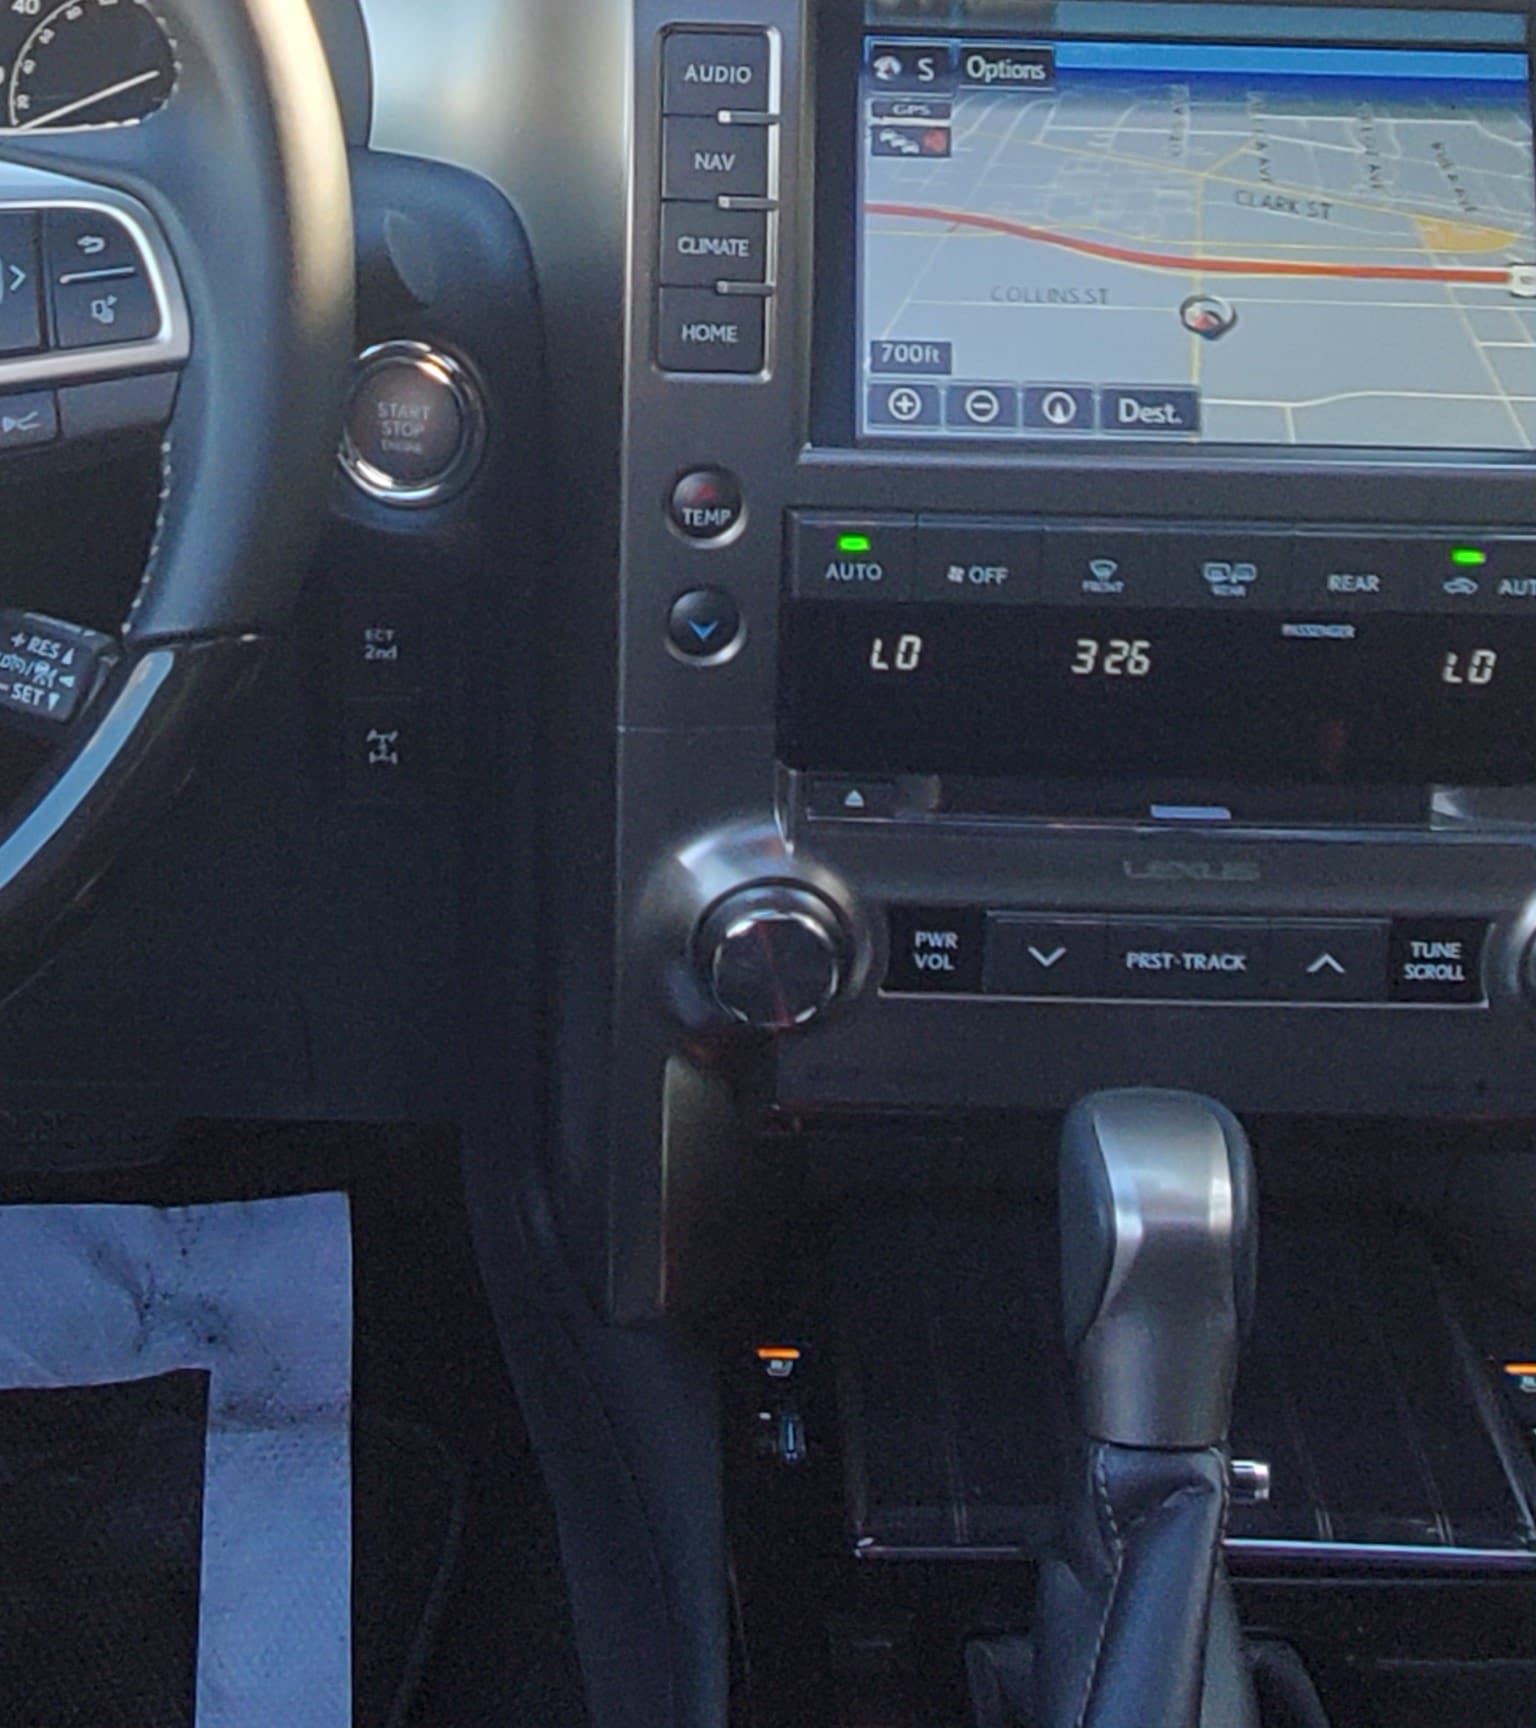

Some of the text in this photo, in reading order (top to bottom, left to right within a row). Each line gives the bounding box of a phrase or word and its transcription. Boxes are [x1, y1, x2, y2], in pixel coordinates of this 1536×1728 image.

[684, 64, 752, 83] AUDIO
[917, 58, 935, 81] S
[966, 55, 1046, 83] Options
[694, 153, 736, 171] NAV
[1235, 189, 1333, 221] CLARK ST
[677, 235, 750, 257] CLIMATE
[990, 285, 1110, 305] COLLINS ST
[681, 324, 738, 343] HOME
[880, 342, 941, 364] 700ft
[377, 401, 431, 420] START
[1118, 397, 1183, 424] Dest.
[381, 420, 425, 437] STOP
[682, 507, 733, 526] TEMP
[825, 563, 883, 582] AUTO
[968, 566, 1009, 585] OFF
[1327, 573, 1380, 594] REAR
[364, 643, 399, 660] 2nd
[10, 682, 46, 707] SET
[1123, 860, 1261, 881] LEXUS
[914, 930, 959, 952] PWR
[1410, 940, 1462, 962] TUNE
[914, 951, 956, 972] VOL
[1403, 962, 1466, 983] SCROLL
